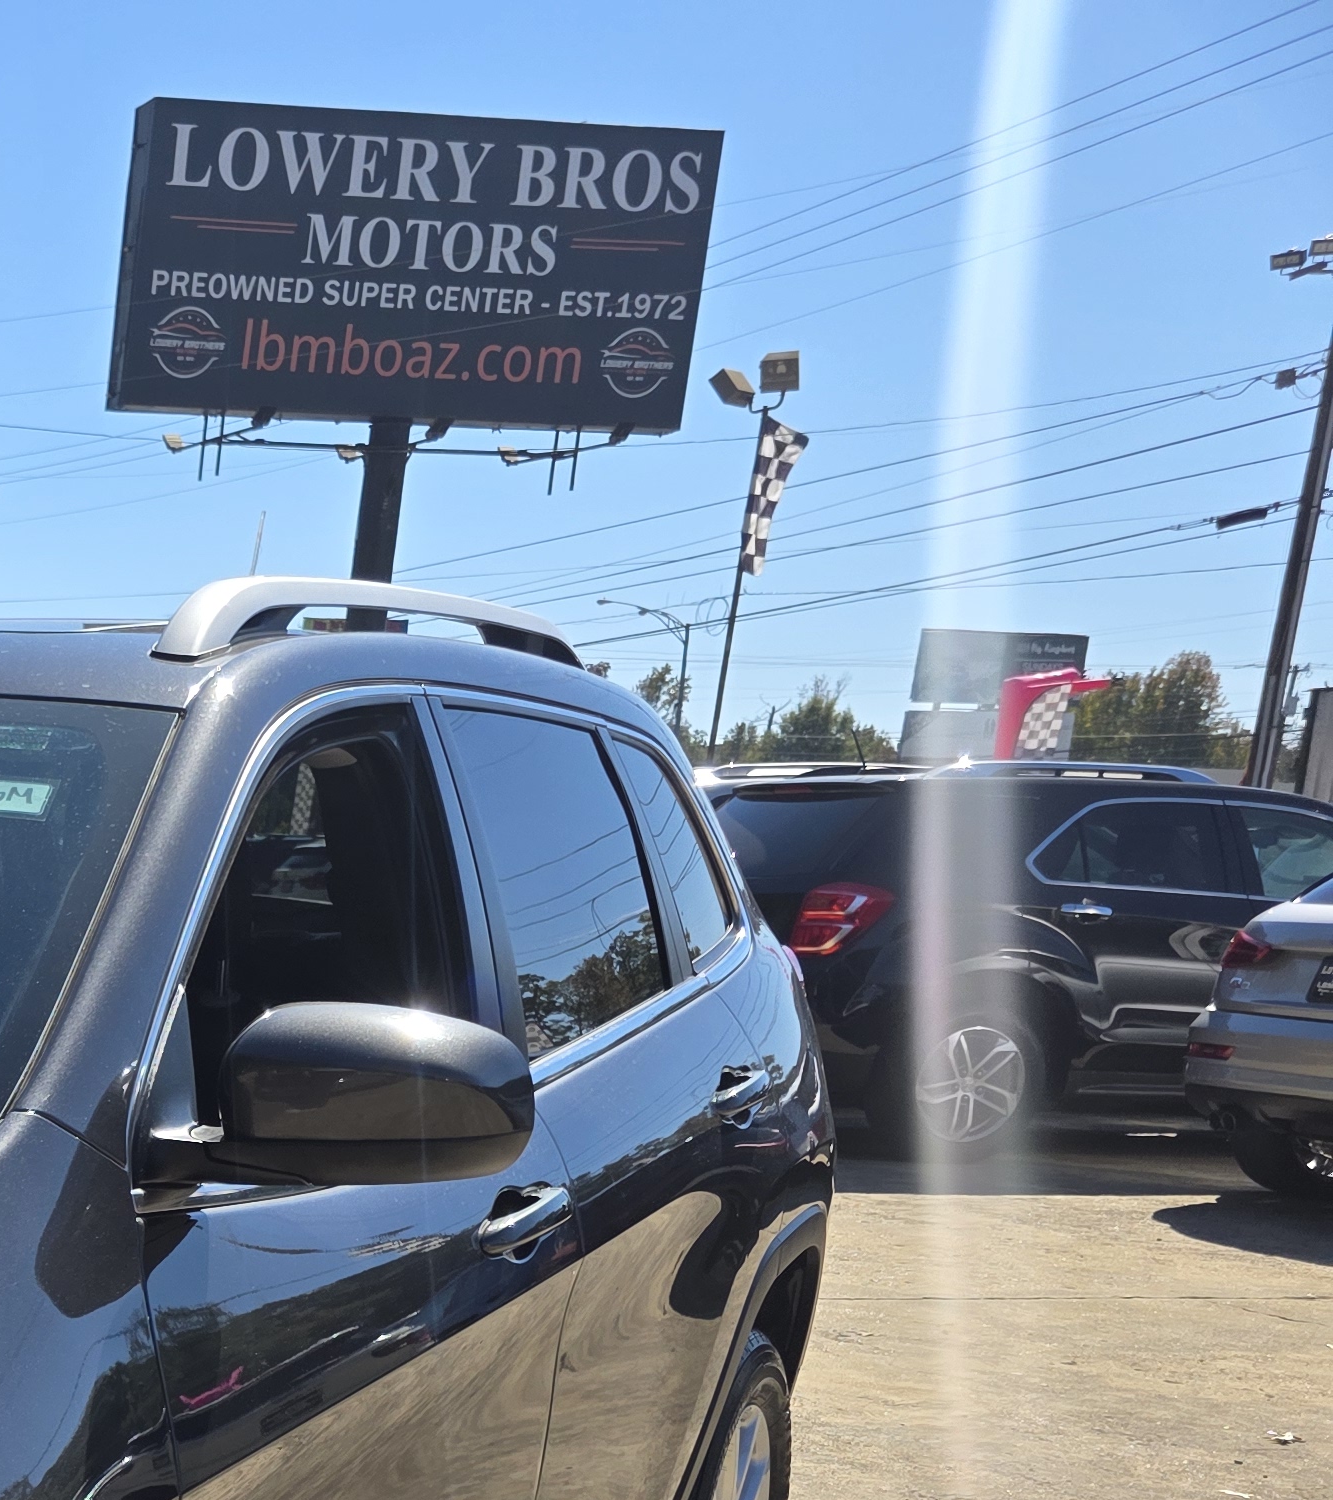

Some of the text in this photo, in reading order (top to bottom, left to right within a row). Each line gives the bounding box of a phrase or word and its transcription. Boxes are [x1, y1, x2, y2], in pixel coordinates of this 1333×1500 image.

[165, 123, 702, 214] LOWERY BROS
[300, 213, 559, 277] MOTORS
[150, 269, 314, 304] PREOWNED
[321, 279, 417, 310] SUPER
[425, 285, 533, 315] CENTER
[558, 290, 687, 321] EST.1972
[240, 318, 582, 384] lbmboaz.com
